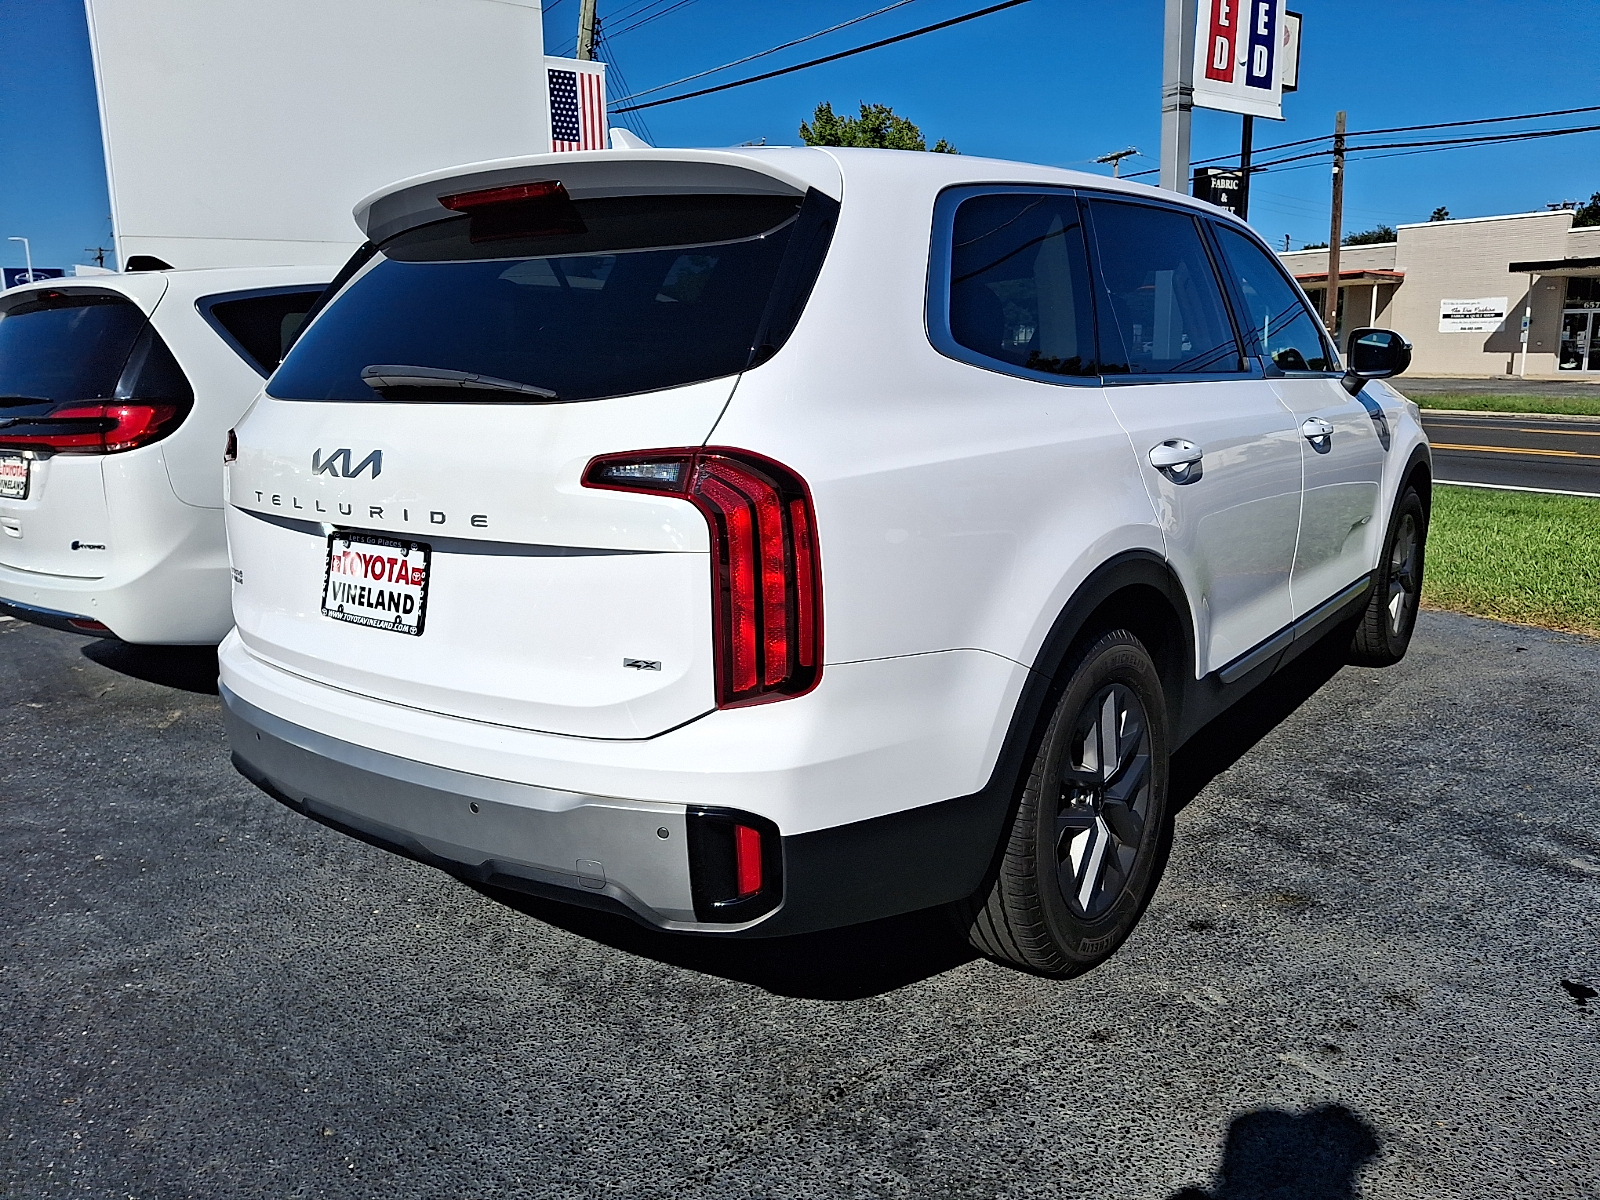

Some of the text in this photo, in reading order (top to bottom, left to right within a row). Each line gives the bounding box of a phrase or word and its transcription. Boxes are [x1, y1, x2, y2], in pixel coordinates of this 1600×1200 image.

[1252, 2, 1270, 78] ED
[1211, 177, 1239, 190] FABRIC
[1221, 192, 1229, 203] &
[254, 490, 489, 528] TELLURIDE
[377, 538, 402, 548] Places
[342, 550, 410, 585] TOYOTA
[332, 580, 415, 615] VINELAND
[328, 609, 410, 633] WWW.TOYOTAVINELAND.COM
